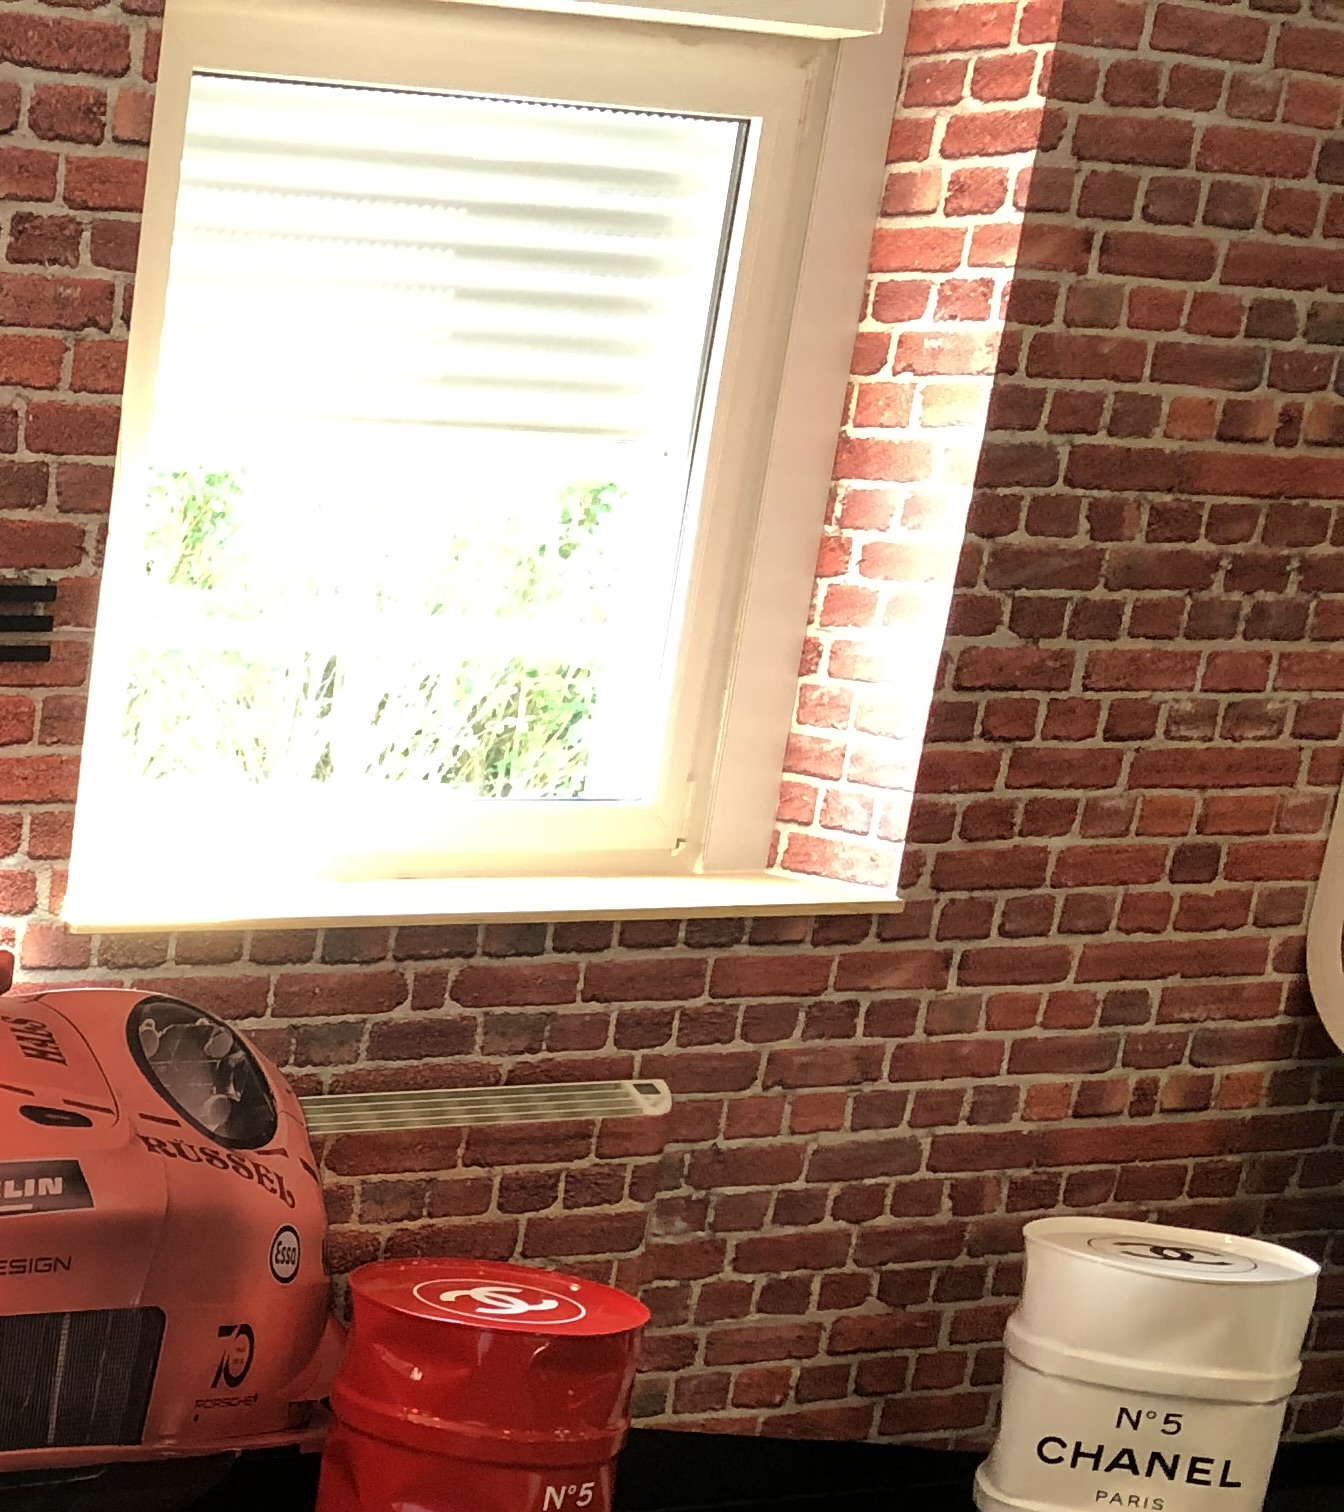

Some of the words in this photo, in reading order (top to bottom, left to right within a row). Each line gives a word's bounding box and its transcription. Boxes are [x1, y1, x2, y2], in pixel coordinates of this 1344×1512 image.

[0, 1015, 68, 1067] HALS
[136, 1133, 296, 1209] RÜSSEL
[274, 1240, 297, 1266] Esso
[1036, 1436, 1242, 1488] CHANEL
[1095, 1489, 1165, 1511] PARIS
